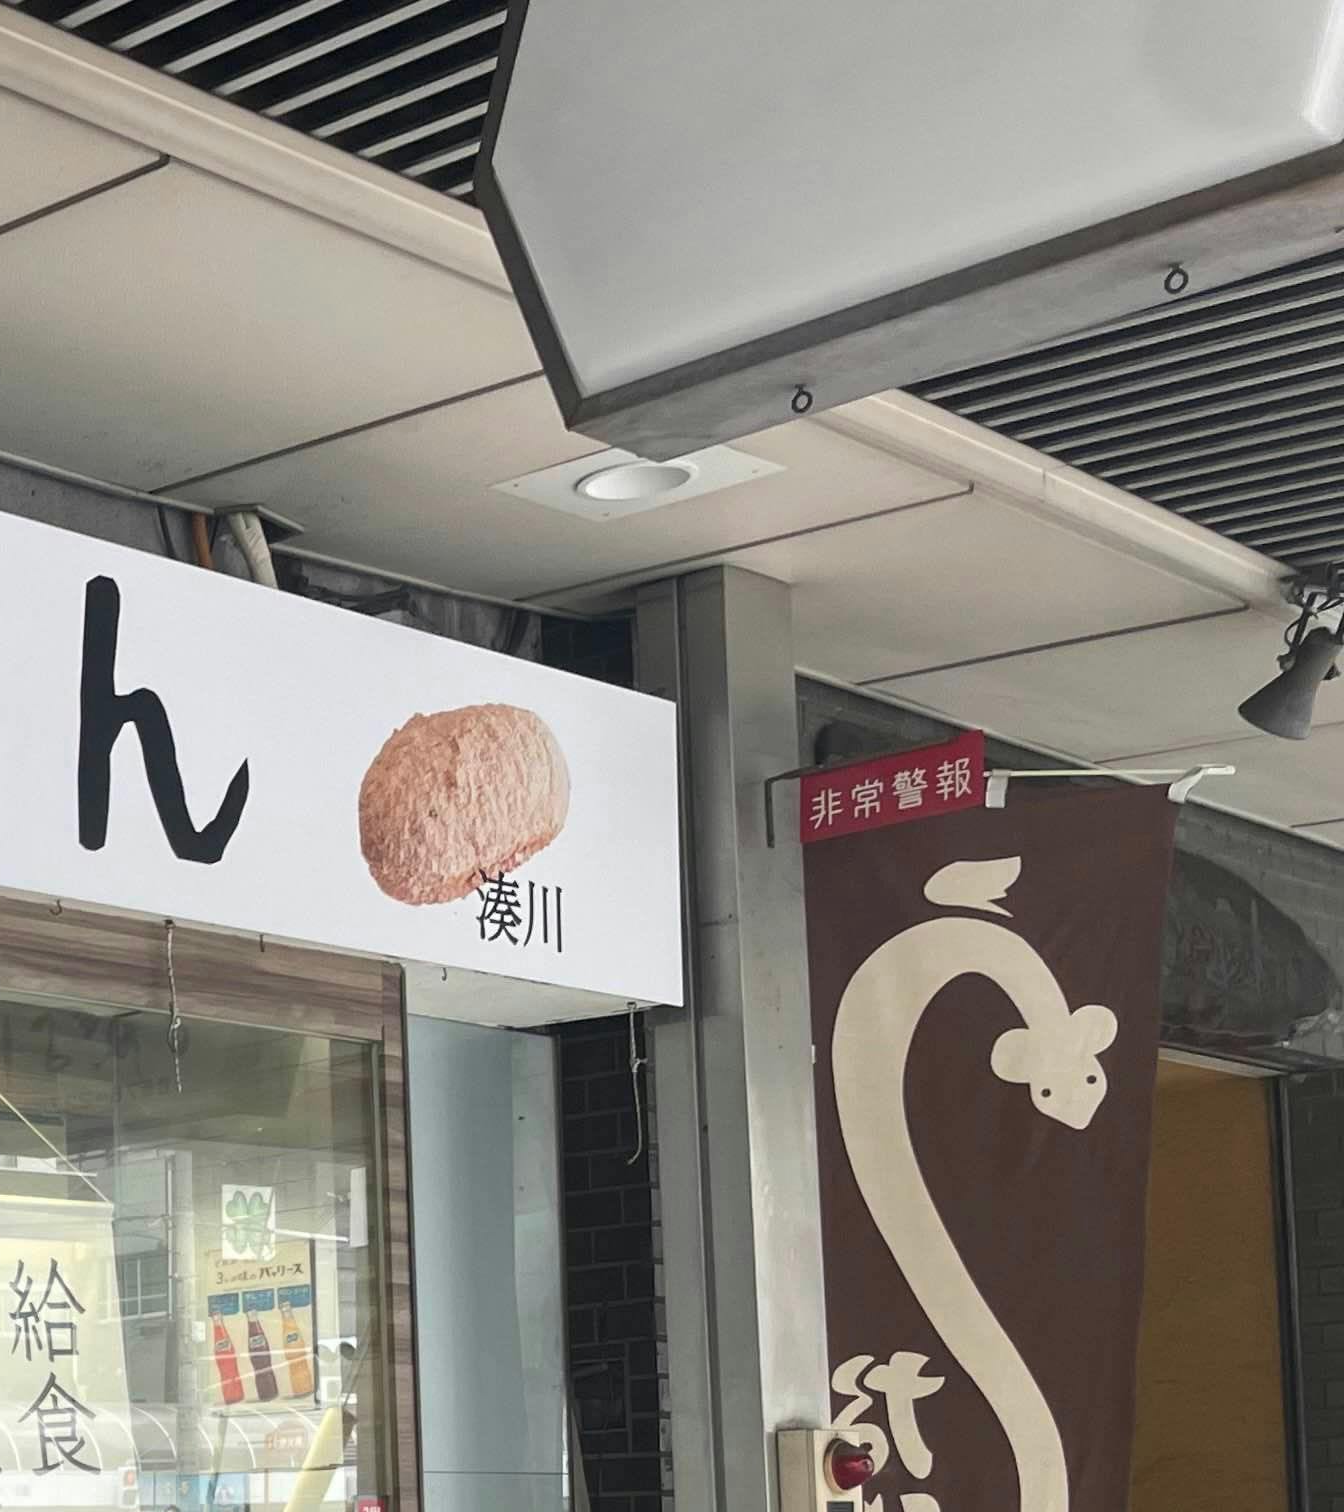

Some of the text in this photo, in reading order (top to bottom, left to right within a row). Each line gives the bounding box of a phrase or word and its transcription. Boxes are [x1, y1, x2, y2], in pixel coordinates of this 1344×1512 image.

[808, 757, 973, 830] 非常警報
[475, 868, 563, 953] 湊川
